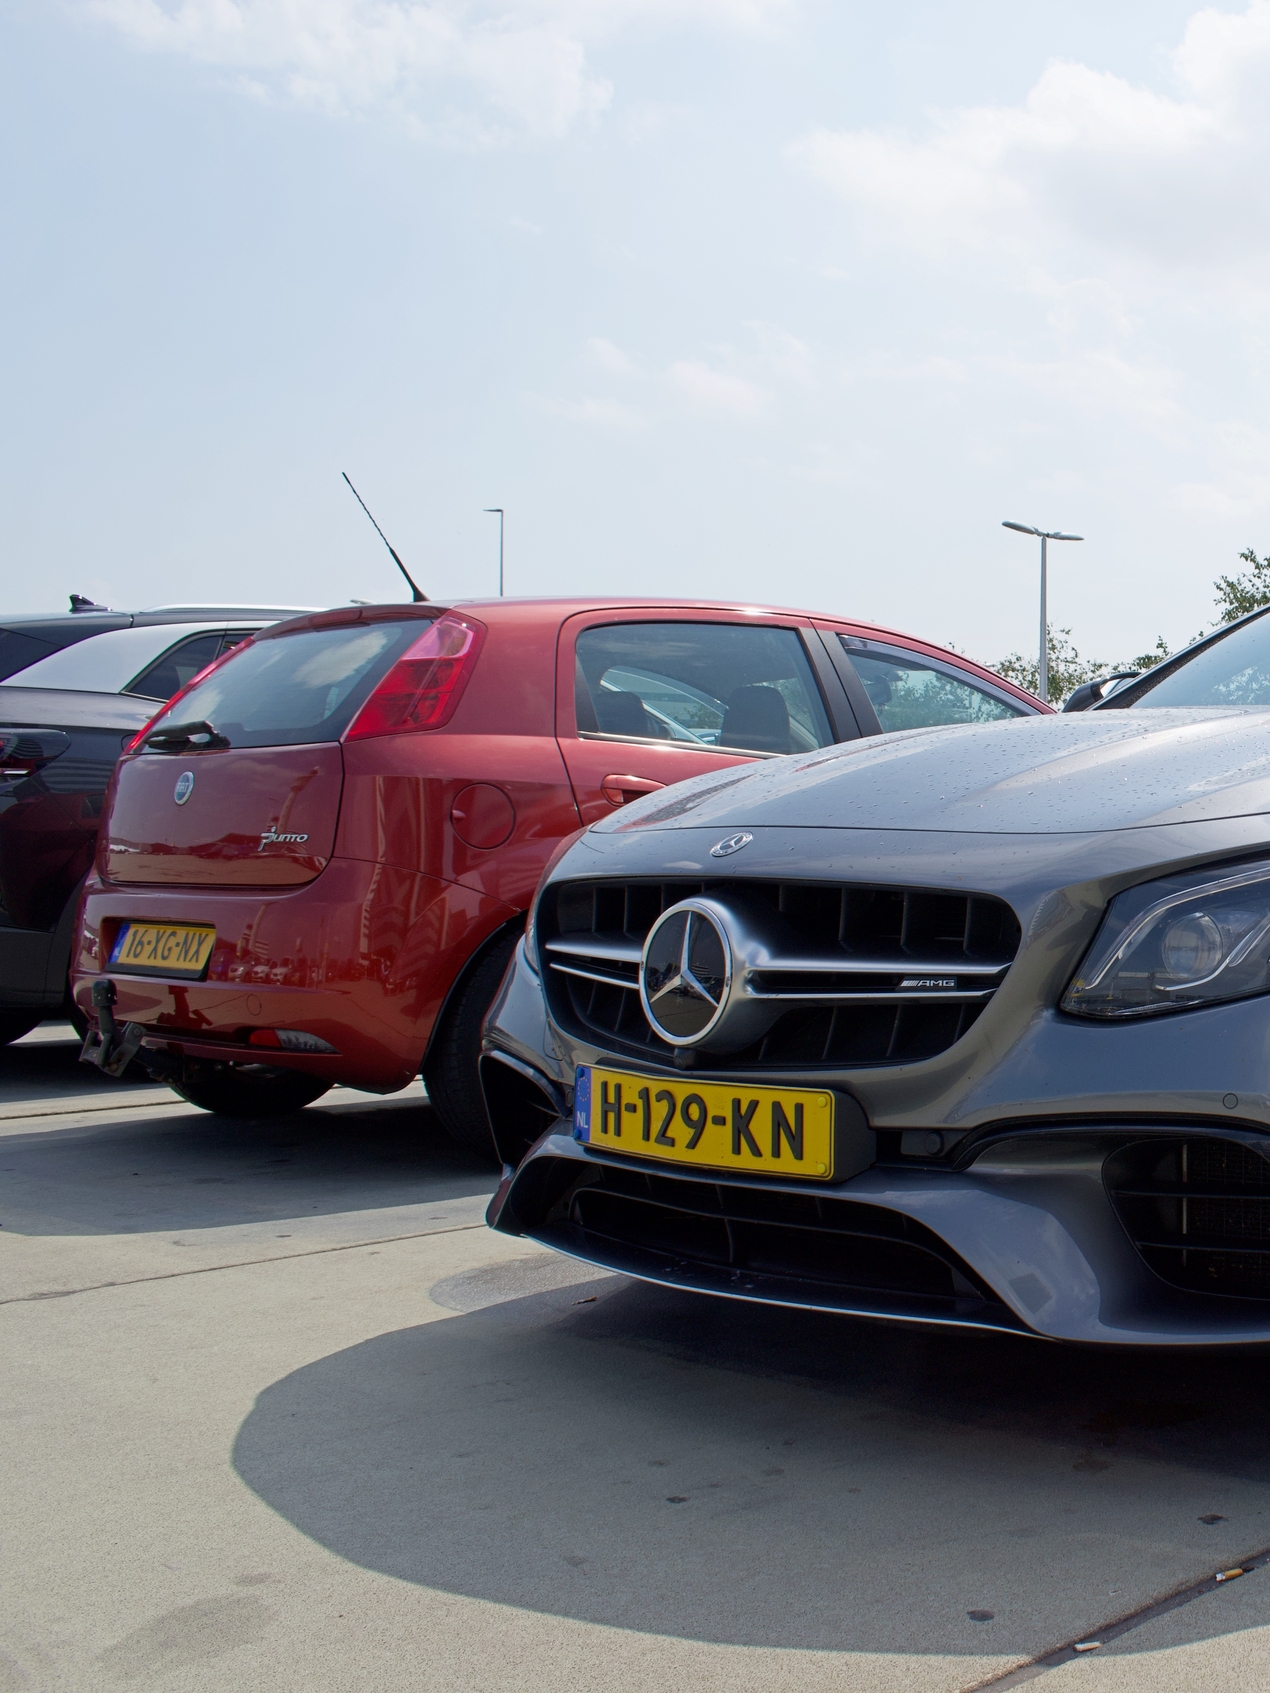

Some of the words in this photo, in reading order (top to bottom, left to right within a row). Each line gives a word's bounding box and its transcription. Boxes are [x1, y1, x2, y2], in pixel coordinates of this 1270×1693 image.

[126, 929, 208, 962] 16-XG-NX
[576, 1111, 589, 1129] NL
[601, 1080, 804, 1161] H-129-KN
